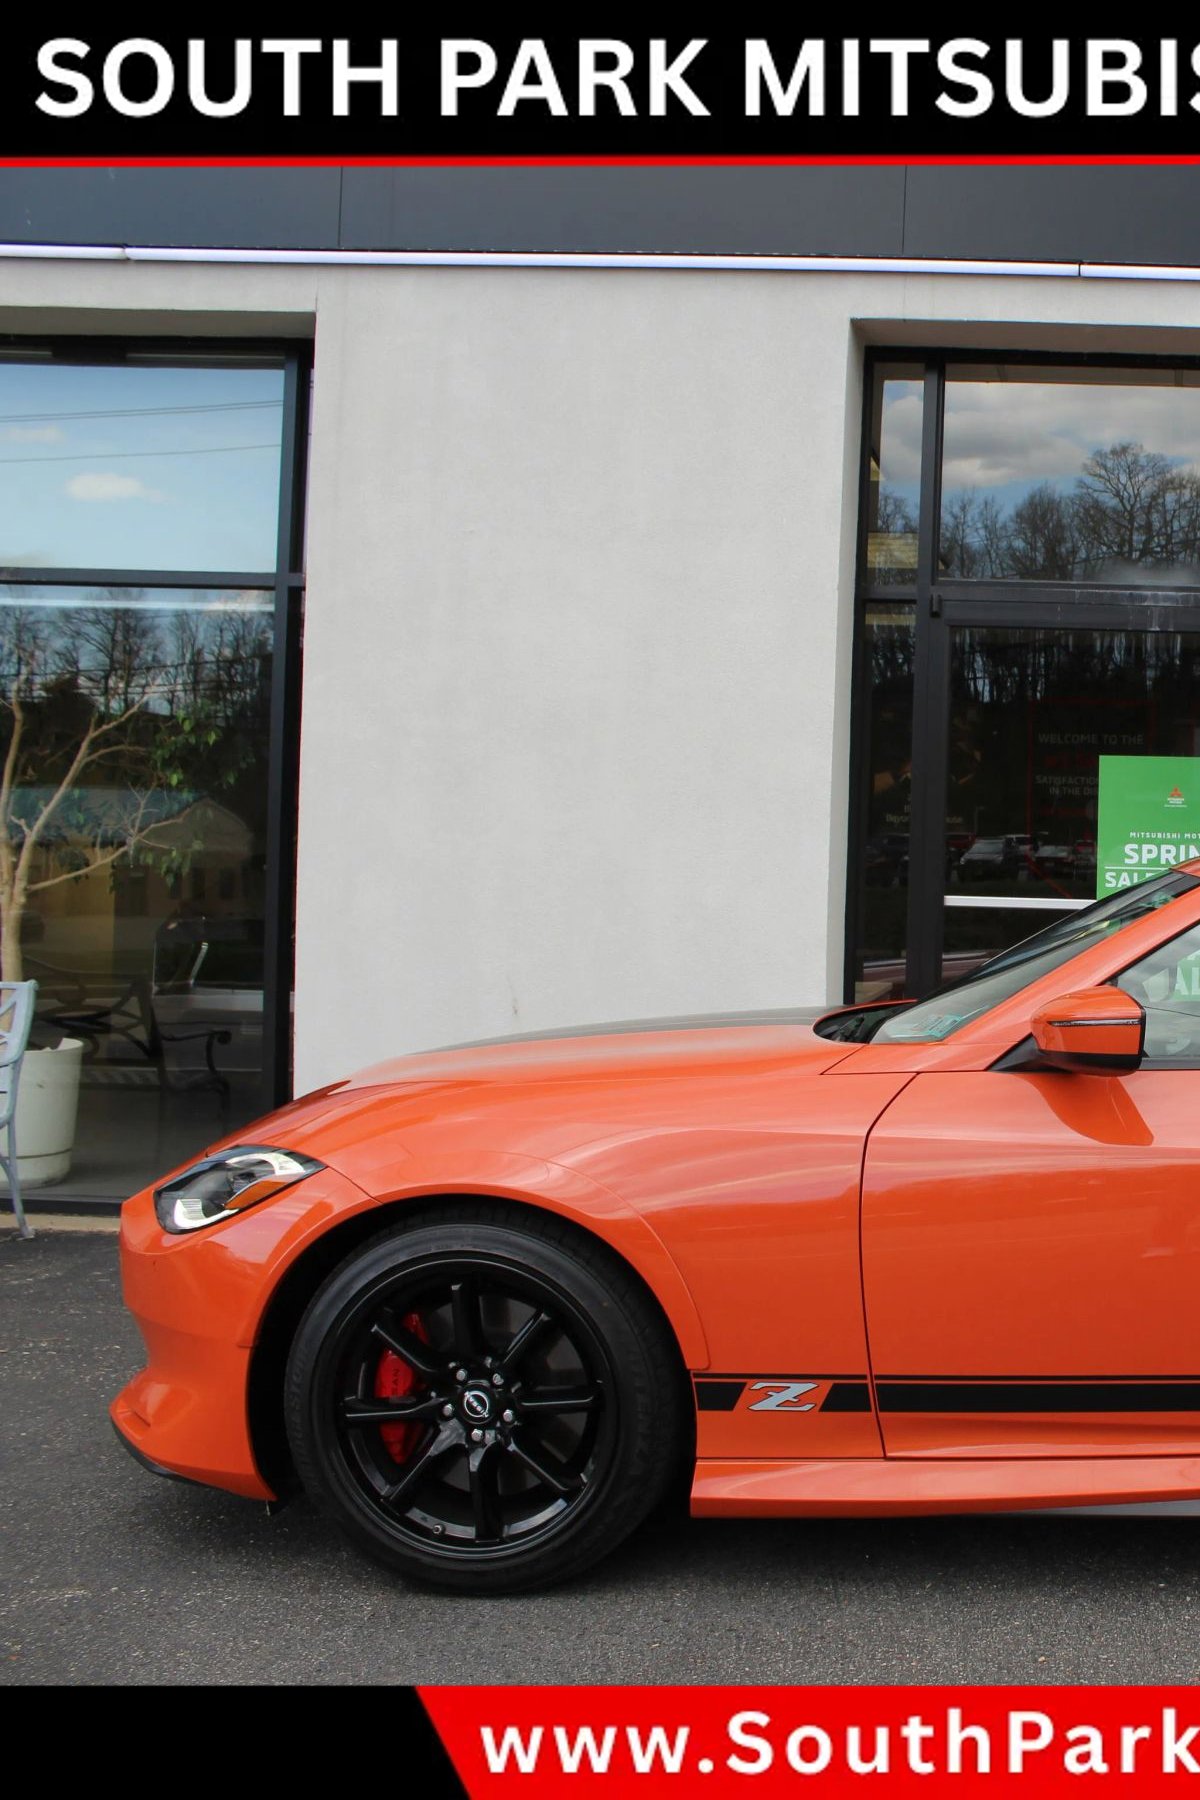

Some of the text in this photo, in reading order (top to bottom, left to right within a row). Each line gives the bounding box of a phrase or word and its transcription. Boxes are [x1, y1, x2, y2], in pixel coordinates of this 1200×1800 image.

[1038, 733, 1145, 745] WELCOME TO THE
[1034, 775, 1098, 786] SATISFACTIO
[1105, 871, 1152, 888] SAL
[747, 1382, 819, 1411] Z
